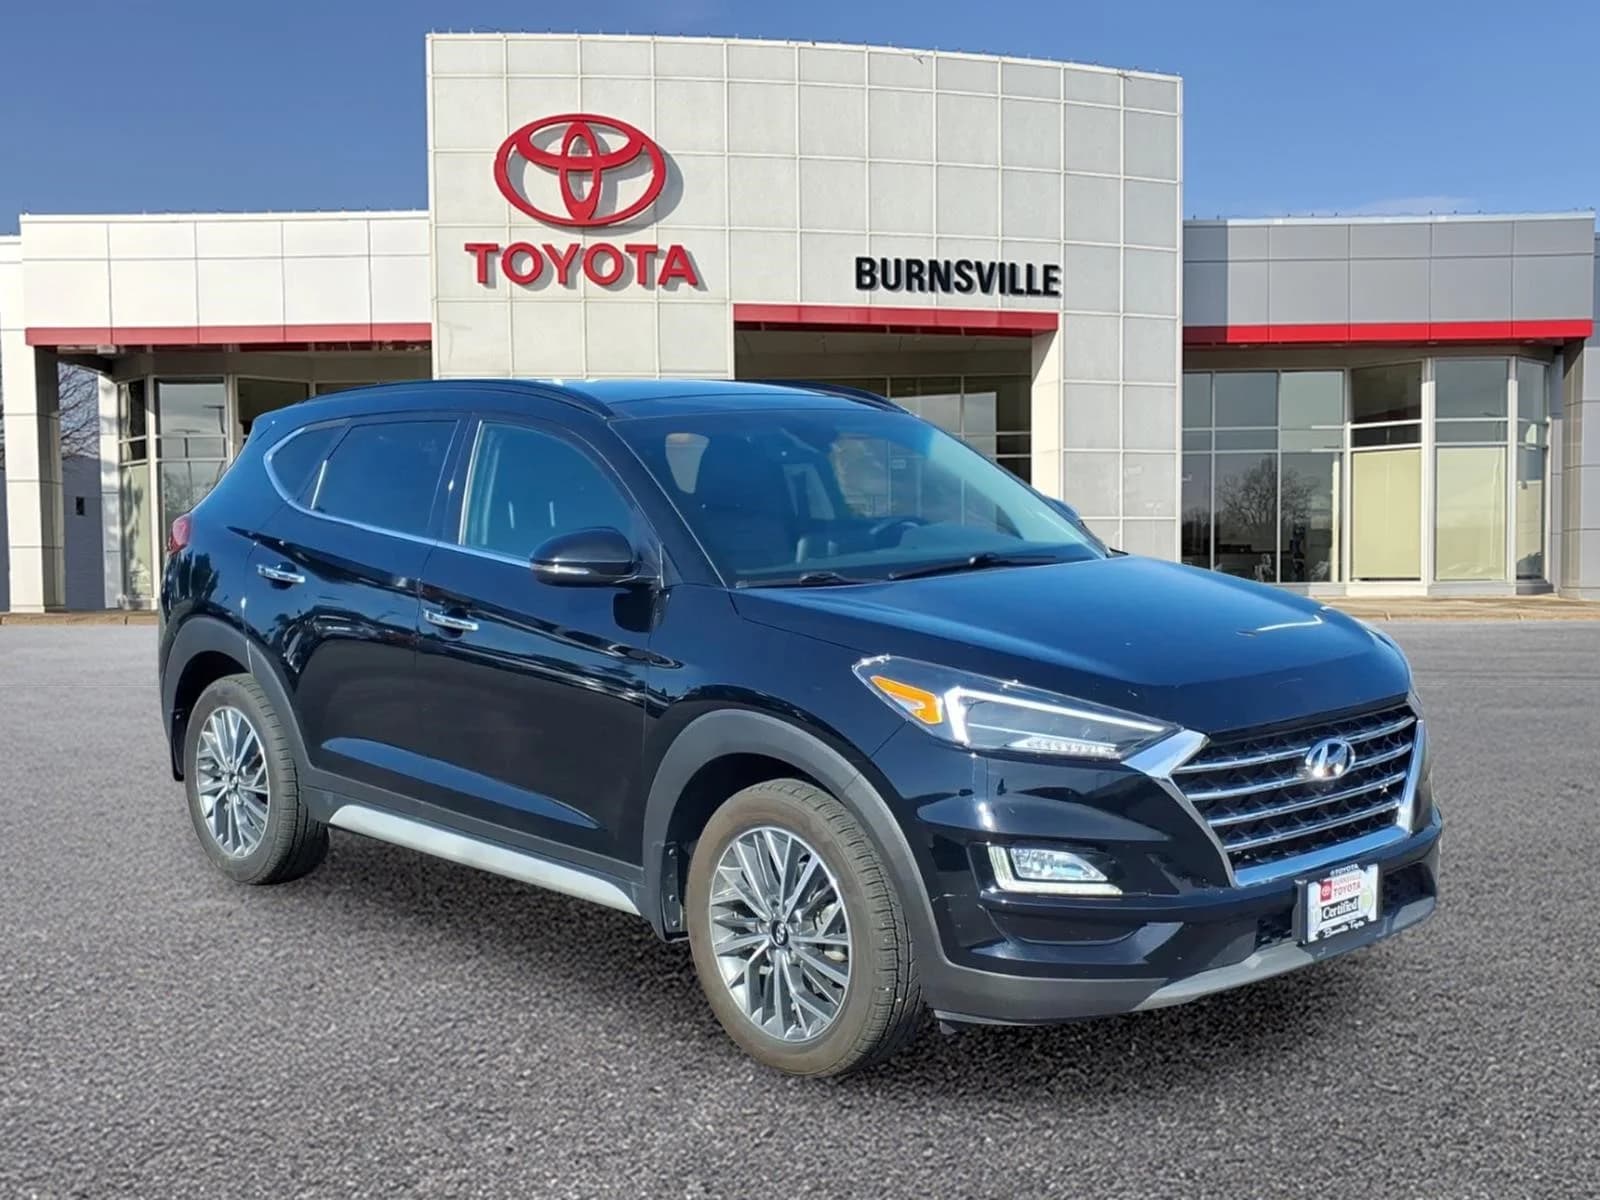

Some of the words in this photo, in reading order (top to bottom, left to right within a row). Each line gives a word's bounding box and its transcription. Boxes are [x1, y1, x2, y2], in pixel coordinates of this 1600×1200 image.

[464, 242, 698, 286] TOYOTA
[855, 256, 1062, 296] BURNSVILLE
[1333, 881, 1361, 896] TOYOTA
[1322, 897, 1357, 919] Certified
